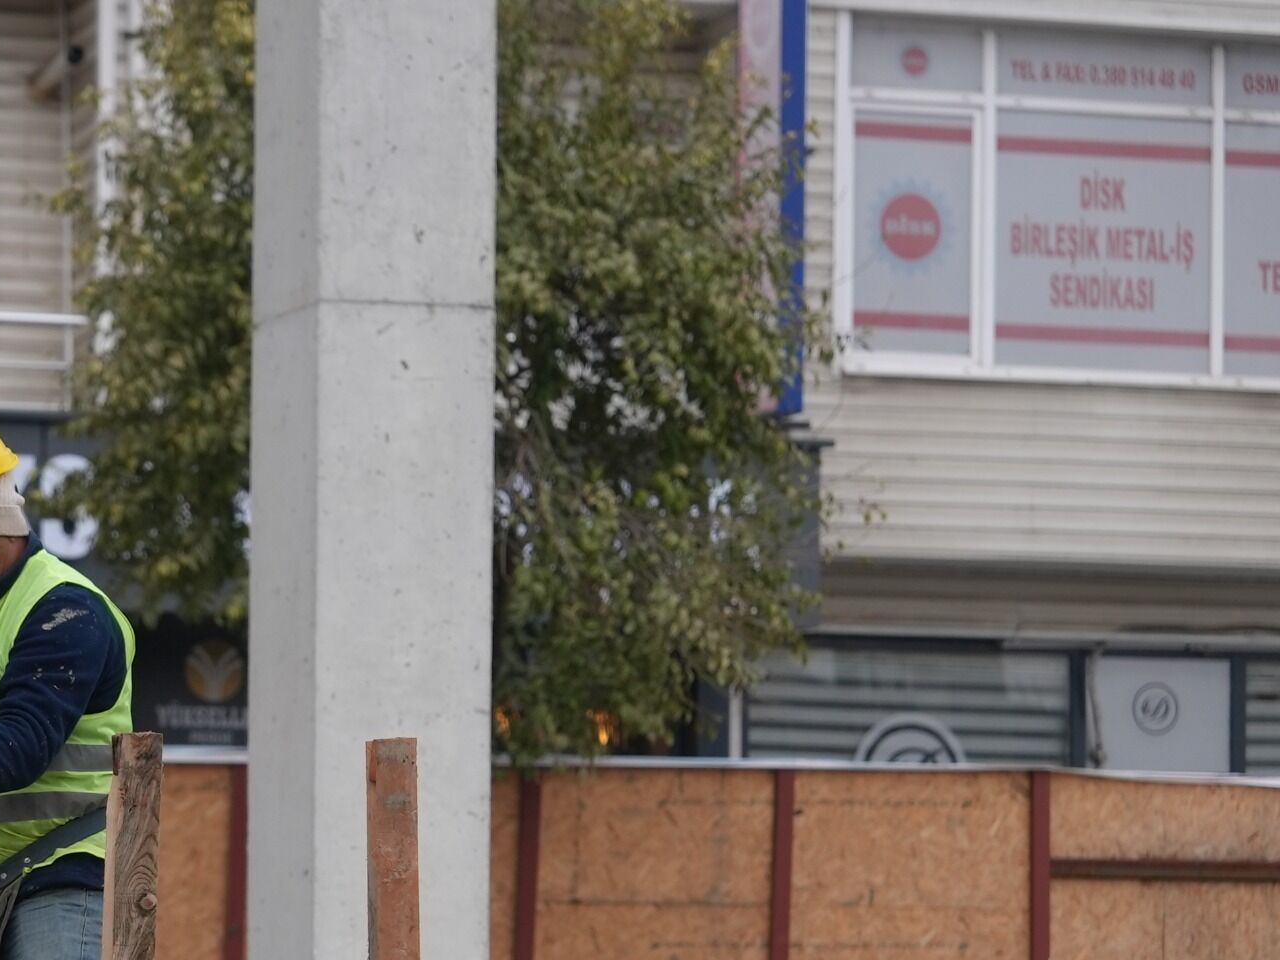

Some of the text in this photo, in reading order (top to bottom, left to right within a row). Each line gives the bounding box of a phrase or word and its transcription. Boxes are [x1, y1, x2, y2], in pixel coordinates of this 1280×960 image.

[1080, 169, 1125, 212] DİSK
[1010, 216, 1195, 273] BİRLEŞİK METAL-İŞ
[1049, 269, 1155, 312] SENDİKASI
